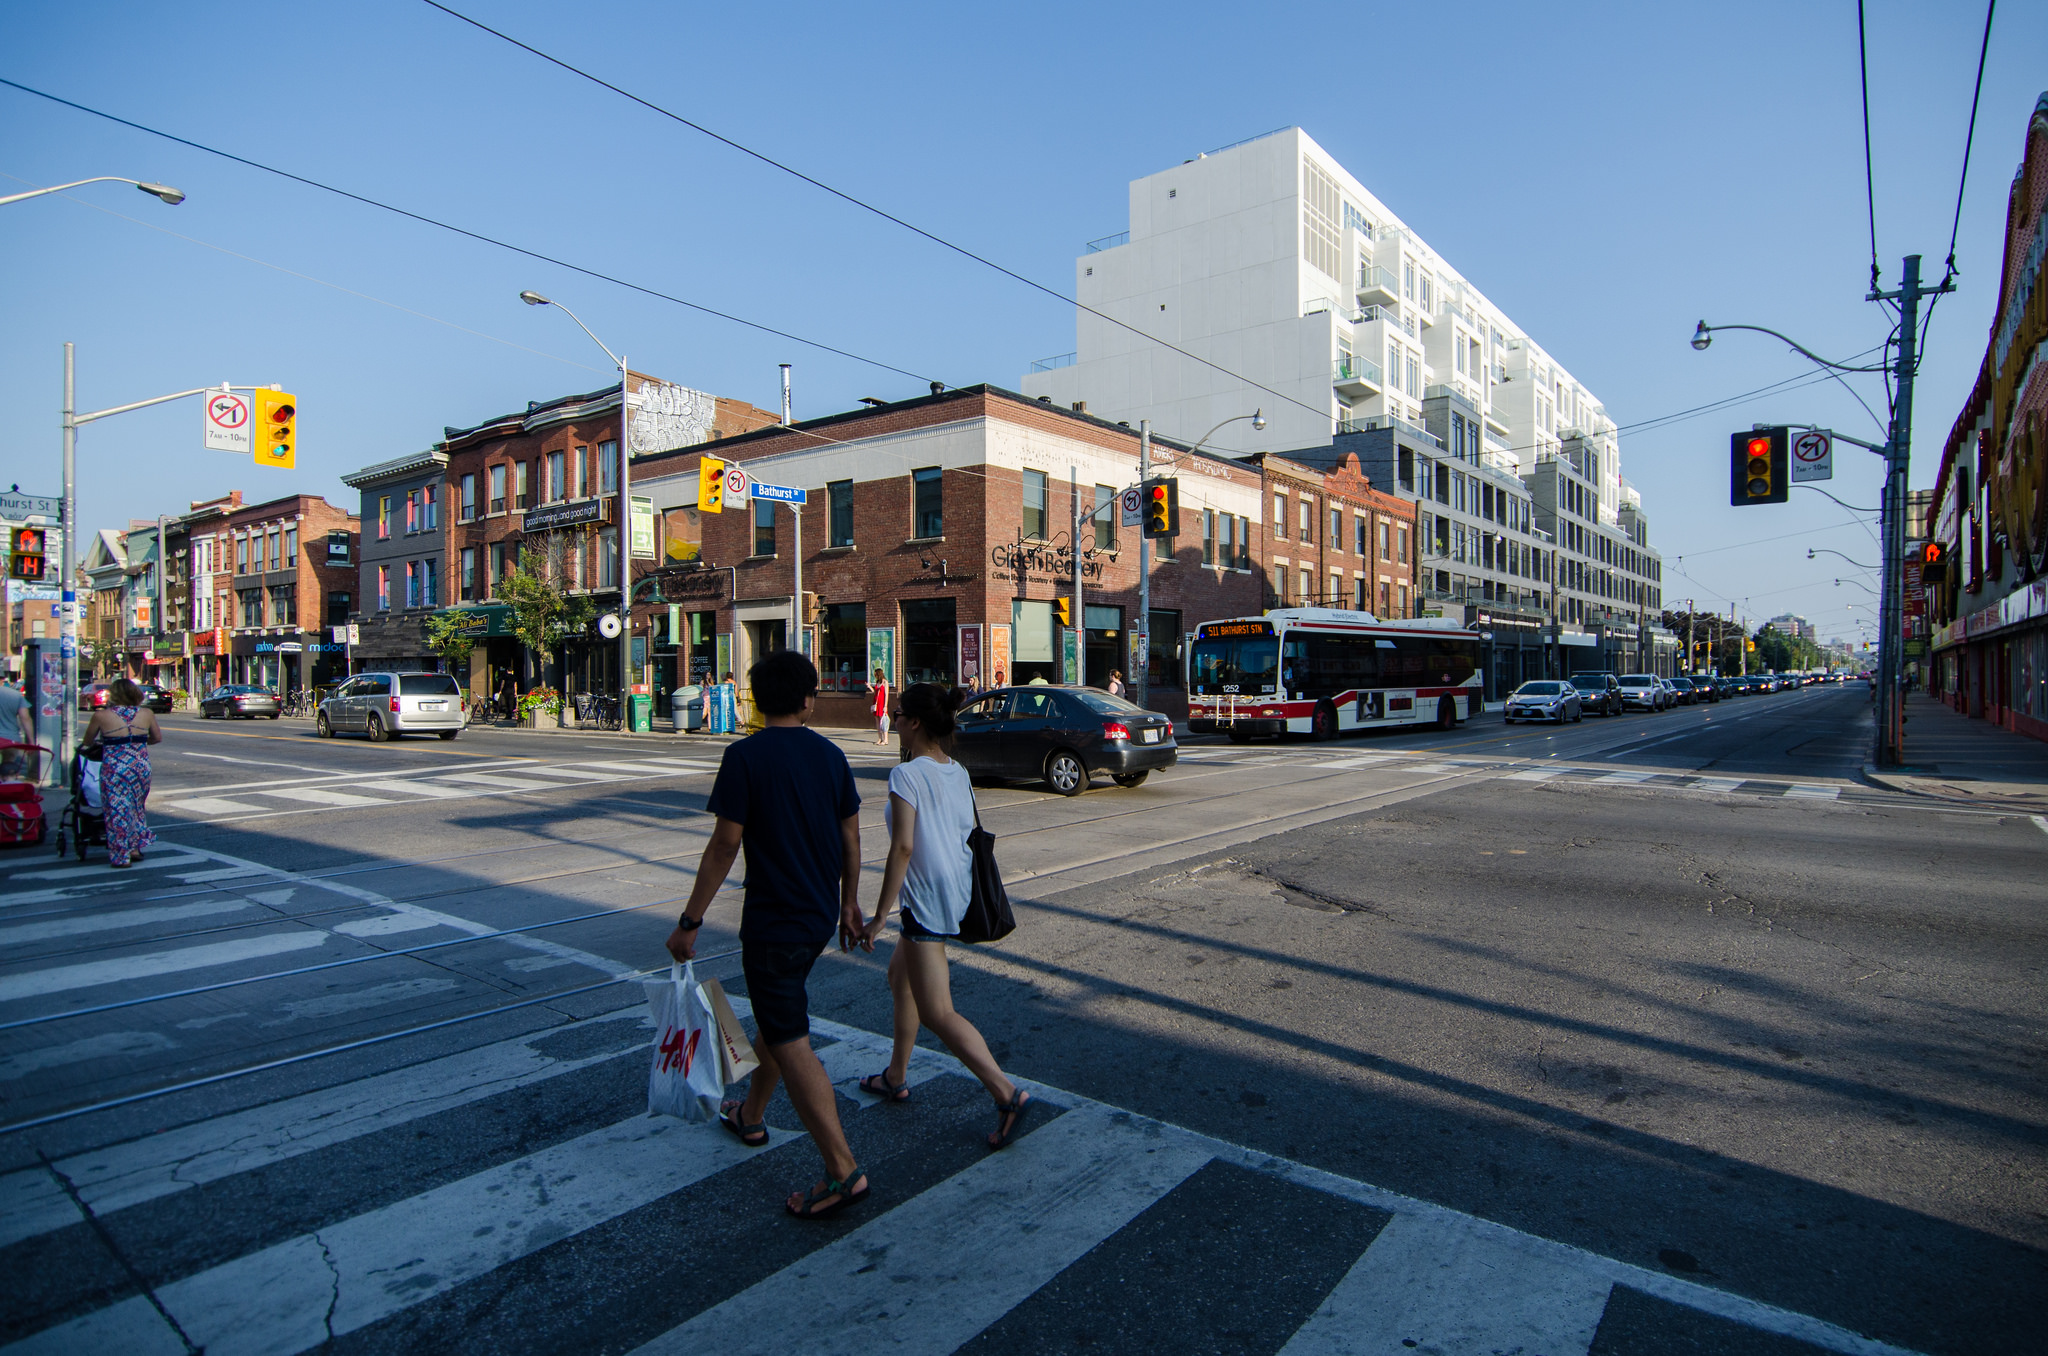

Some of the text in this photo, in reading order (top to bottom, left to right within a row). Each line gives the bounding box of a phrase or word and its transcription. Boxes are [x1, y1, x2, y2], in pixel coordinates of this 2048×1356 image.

[209, 430, 223, 439] 7AM
[230, 432, 247, 442] 10PM
[1795, 465, 1806, 473] 7AM
[1813, 463, 1828, 472] 10PM
[758, 484, 793, 499] Bathurst
[38, 500, 50, 511] St
[526, 515, 539, 528] good
[570, 508, 584, 521] good
[23, 556, 38, 575] 14
[1045, 551, 1104, 582] Beaery
[1208, 624, 1263, 637] 511 BATHURST STN
[689, 656, 709, 664] COFFEE
[689, 665, 712, 673] ROASTED
[1222, 684, 1240, 693] 1252
[656, 1025, 702, 1080] H&M
